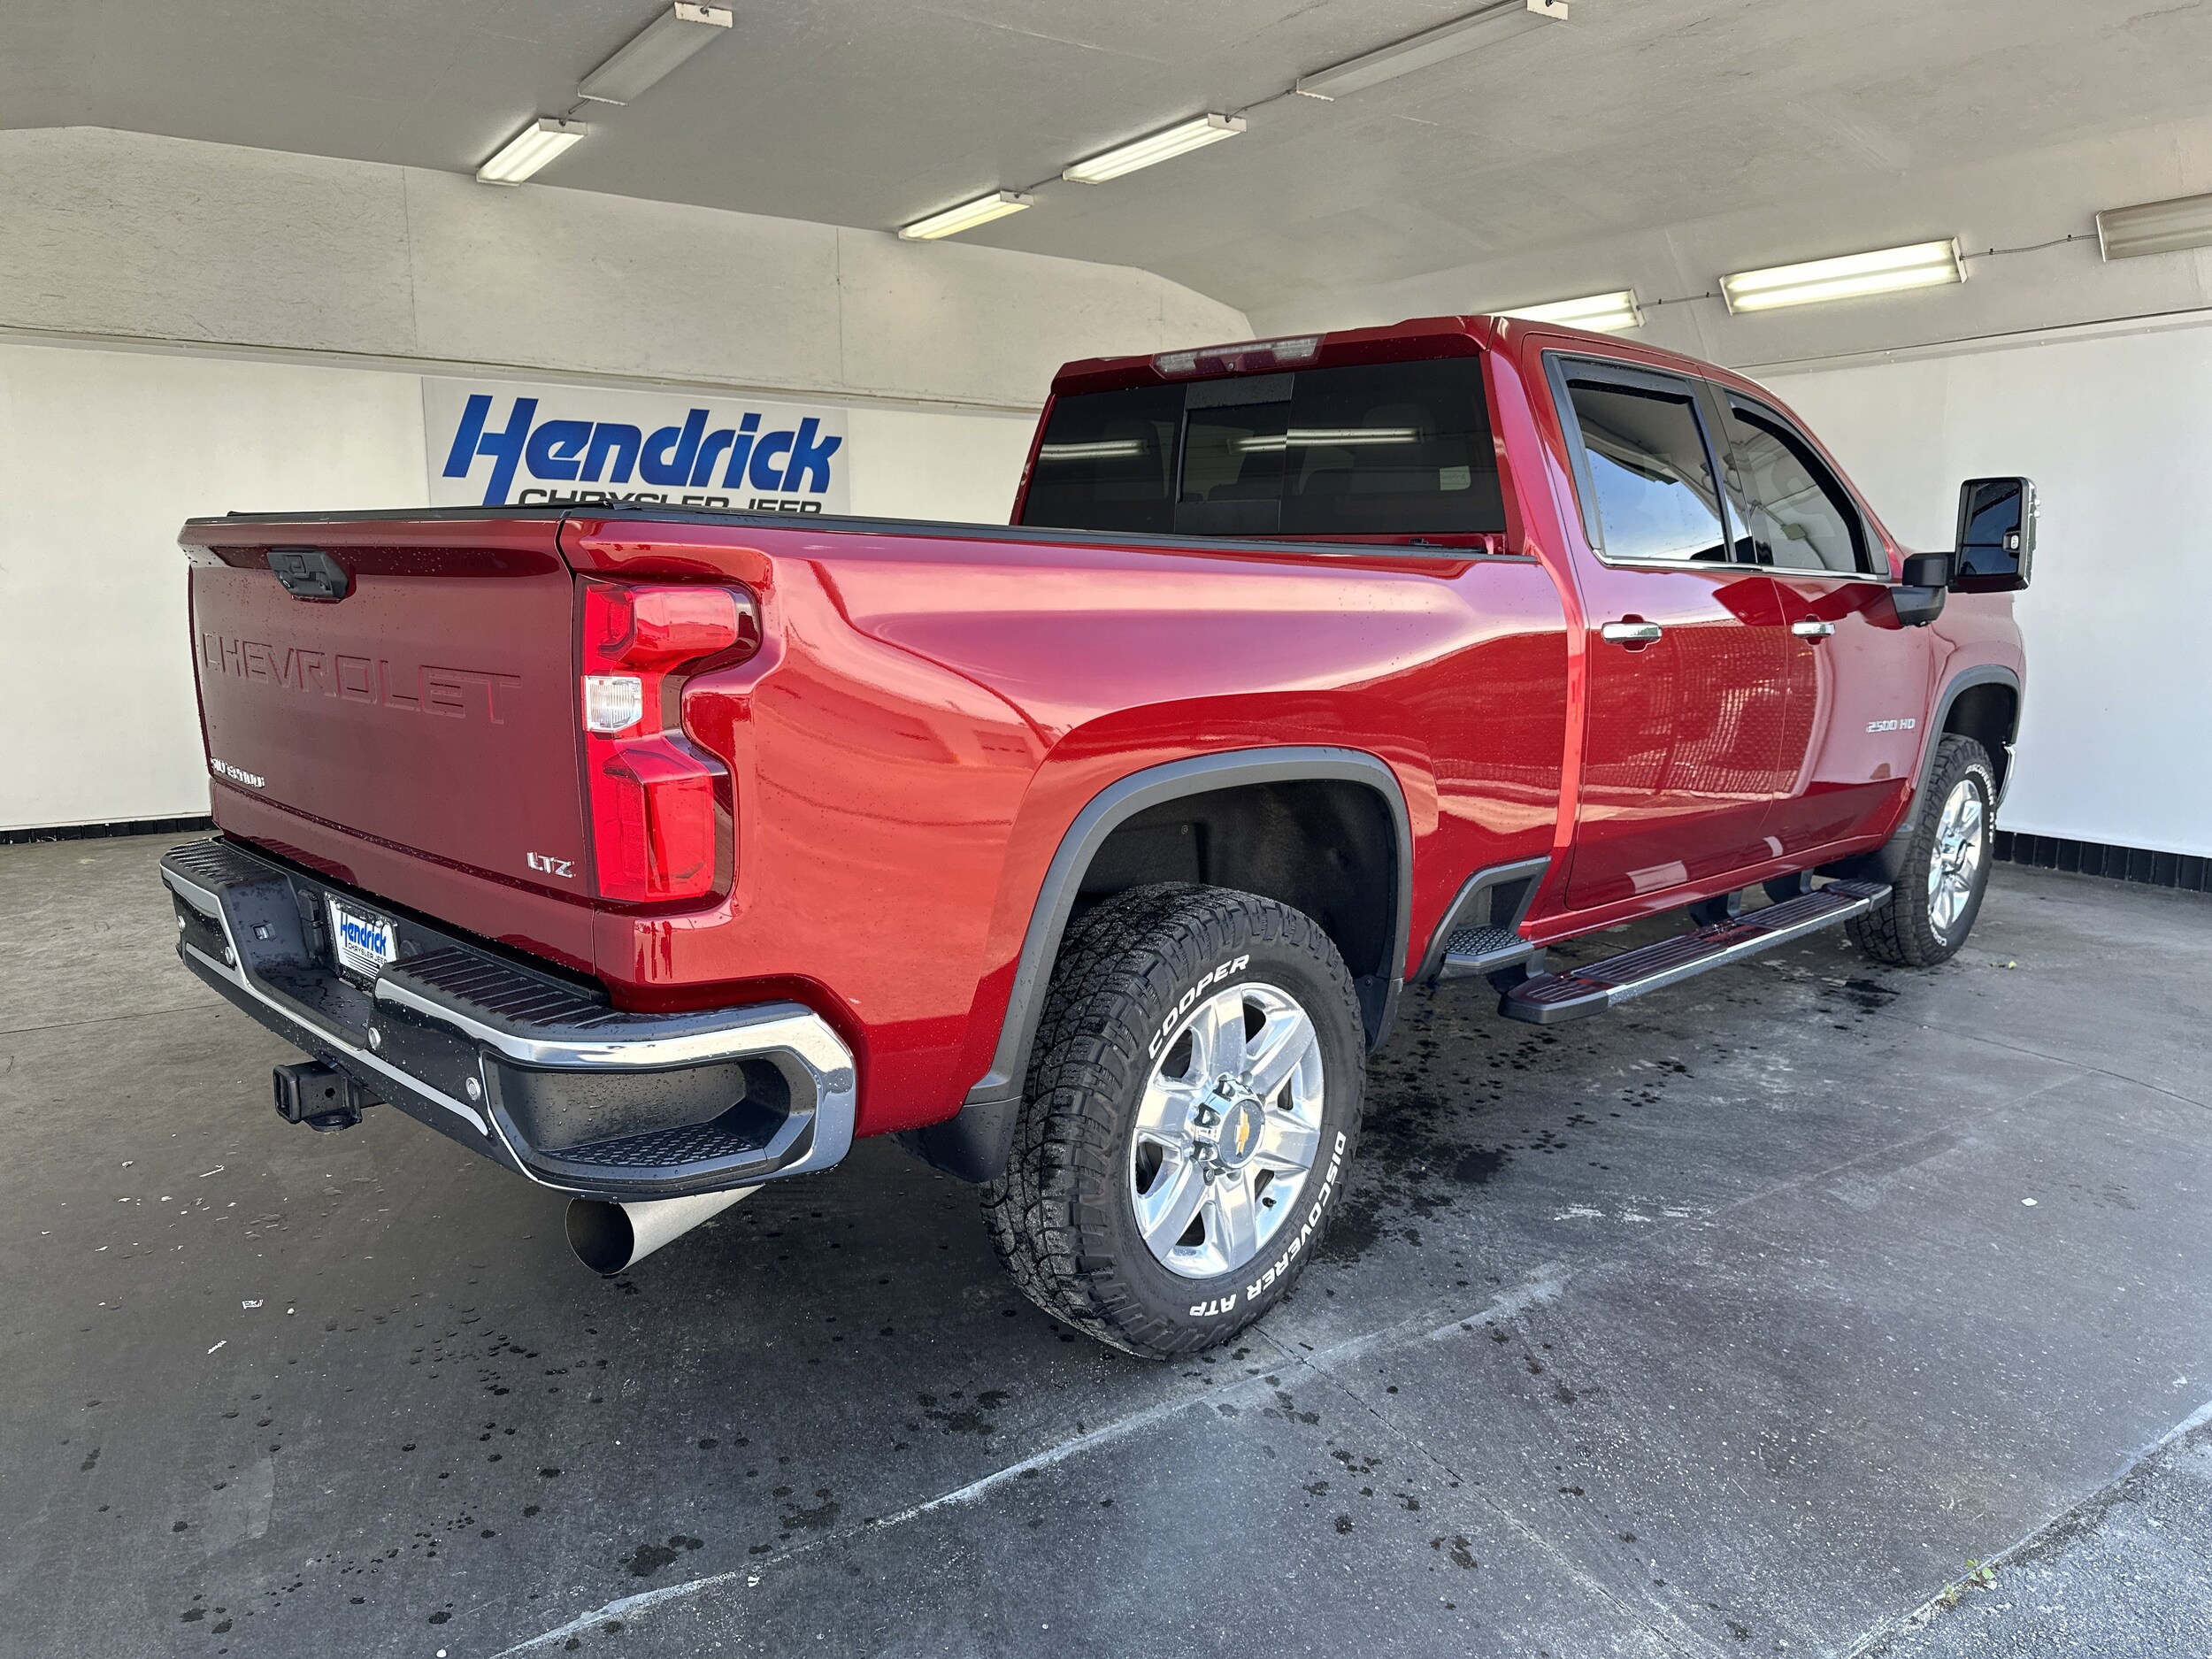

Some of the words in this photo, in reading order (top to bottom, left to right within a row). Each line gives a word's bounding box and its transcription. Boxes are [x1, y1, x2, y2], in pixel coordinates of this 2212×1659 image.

[442, 394, 842, 506] Hendrick
[202, 632, 522, 725] CHEVROLET
[1866, 719, 1898, 733] 2500
[1899, 718, 1916, 730] HD
[526, 851, 577, 879] LTZ
[340, 911, 388, 956] Hendrick
[348, 942, 374, 960] CHRYSLER
[1148, 954, 1250, 1060] COOPER
[1246, 1131, 1347, 1302] DISCOVERER
[1189, 1294, 1237, 1317] ATP
